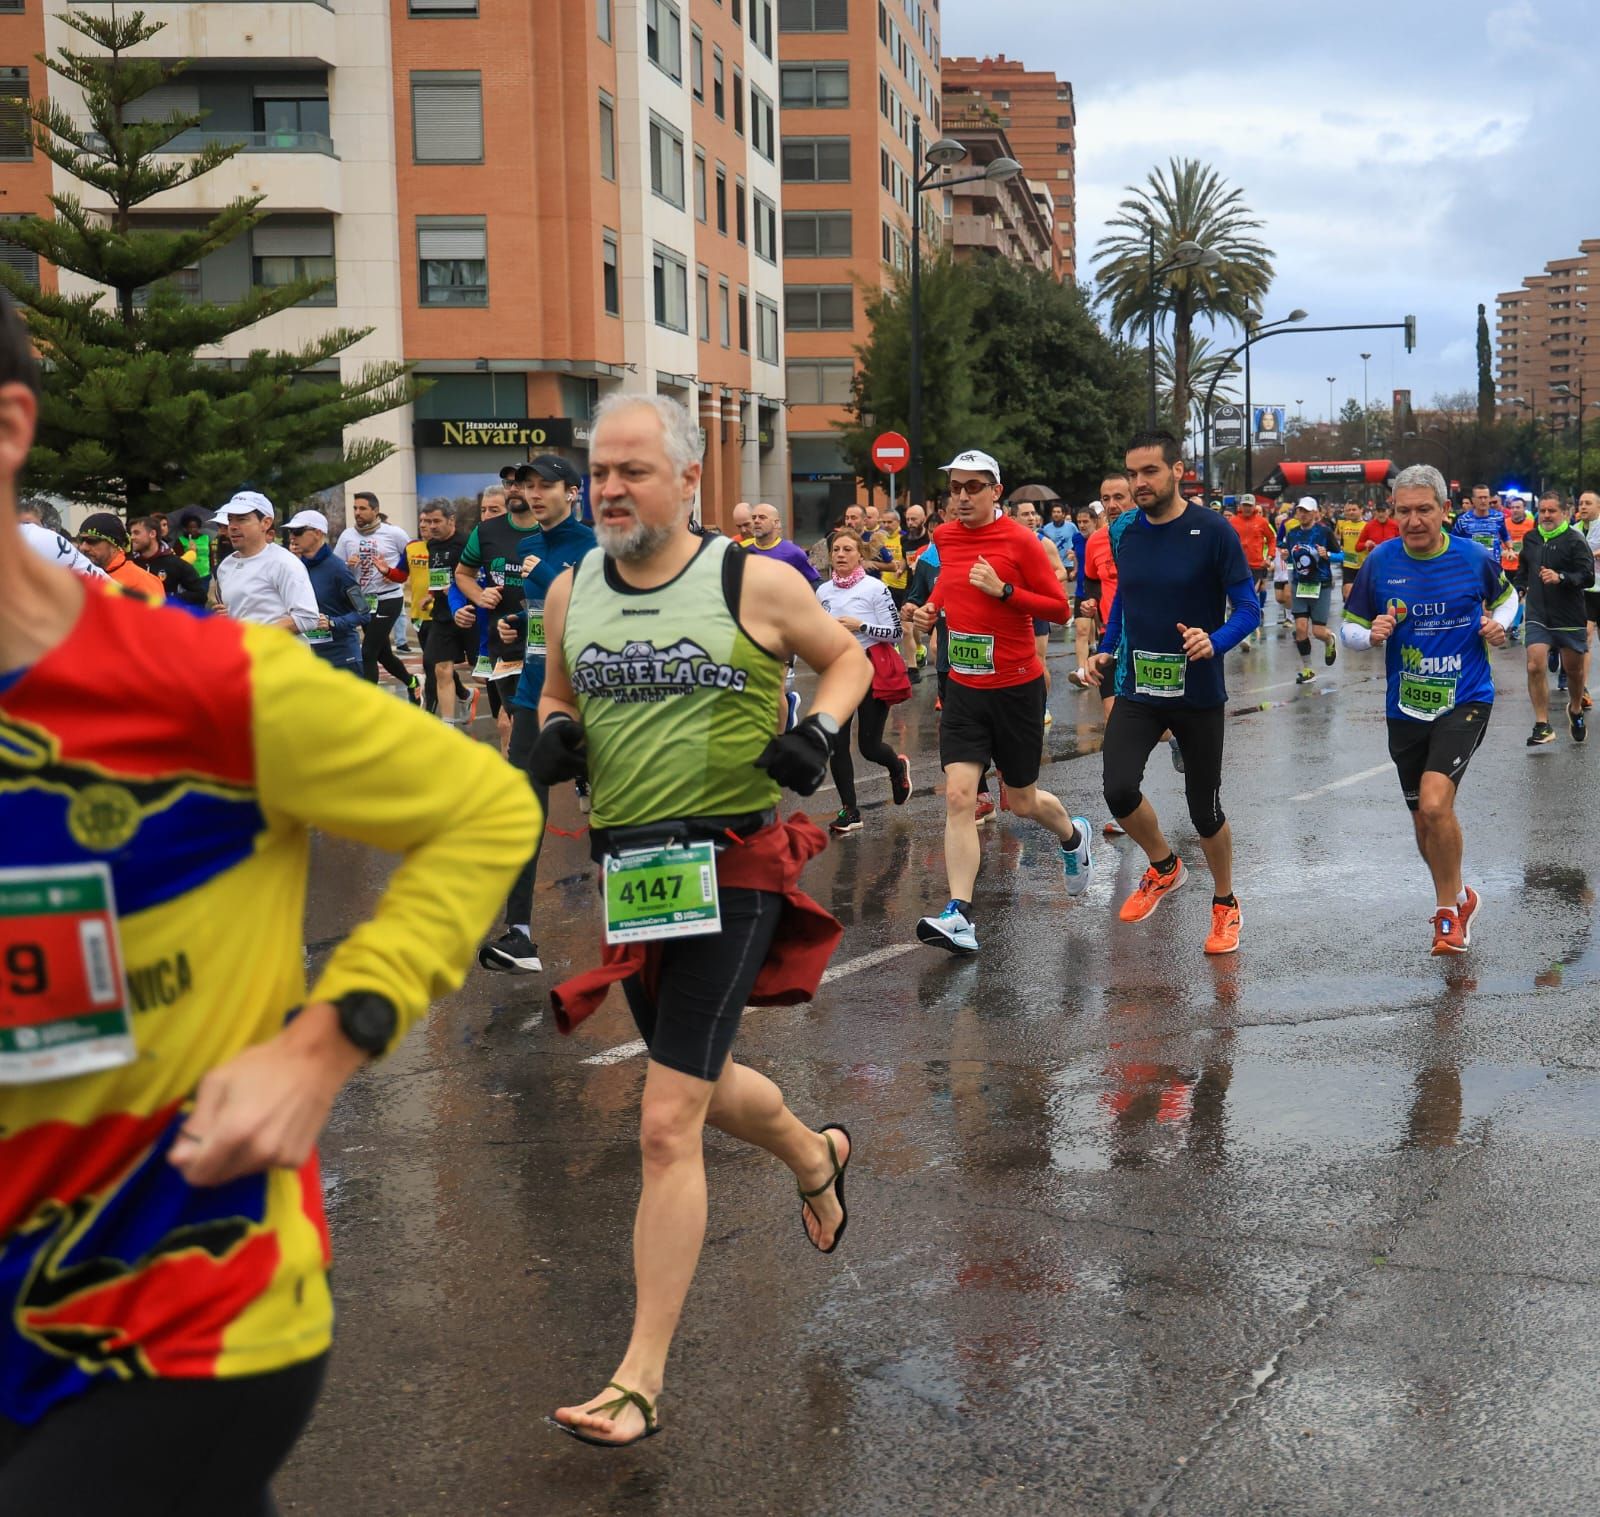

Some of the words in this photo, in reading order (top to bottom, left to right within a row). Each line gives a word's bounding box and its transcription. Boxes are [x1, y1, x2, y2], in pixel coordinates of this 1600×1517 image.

[442, 422, 546, 445] Navarro
[466, 422, 518, 430] HERBOLARIO
[1412, 602, 1447, 616] CEU
[1414, 619, 1440, 628] Colegio
[868, 626, 891, 639] KEEP
[953, 645, 979, 659] 4170
[1419, 654, 1462, 674] RUN
[571, 660, 748, 694] URCIELAGOS
[1143, 665, 1172, 680] 4169
[1404, 687, 1442, 703] 4399
[619, 874, 684, 905] 4147
[1, 941, 49, 997] 9
